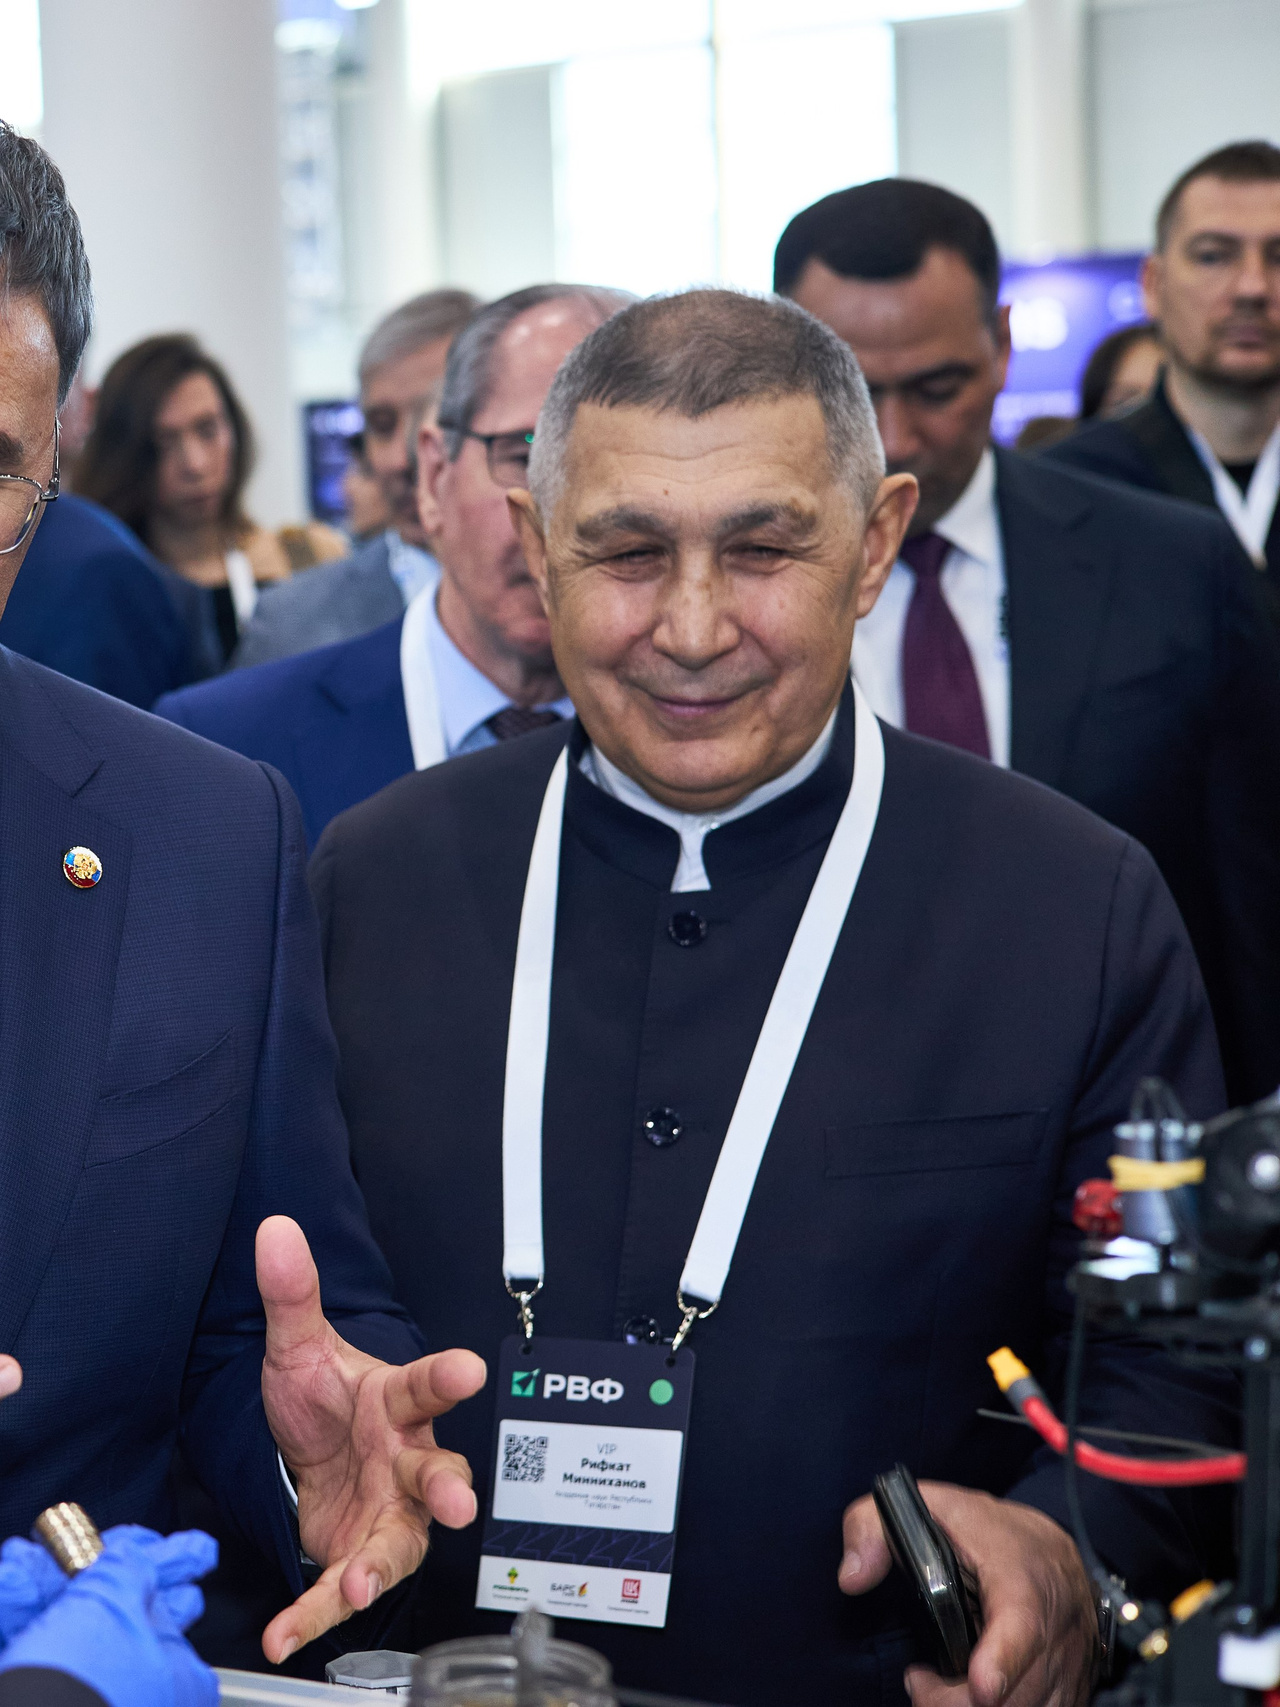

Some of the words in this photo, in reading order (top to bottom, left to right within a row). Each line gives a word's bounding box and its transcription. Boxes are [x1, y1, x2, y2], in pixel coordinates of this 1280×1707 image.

[543, 1373, 624, 1404] РВФ
[597, 1443, 617, 1455] VIP
[581, 1458, 631, 1472] Рифкат
[562, 1472, 647, 1489] Минниханов
